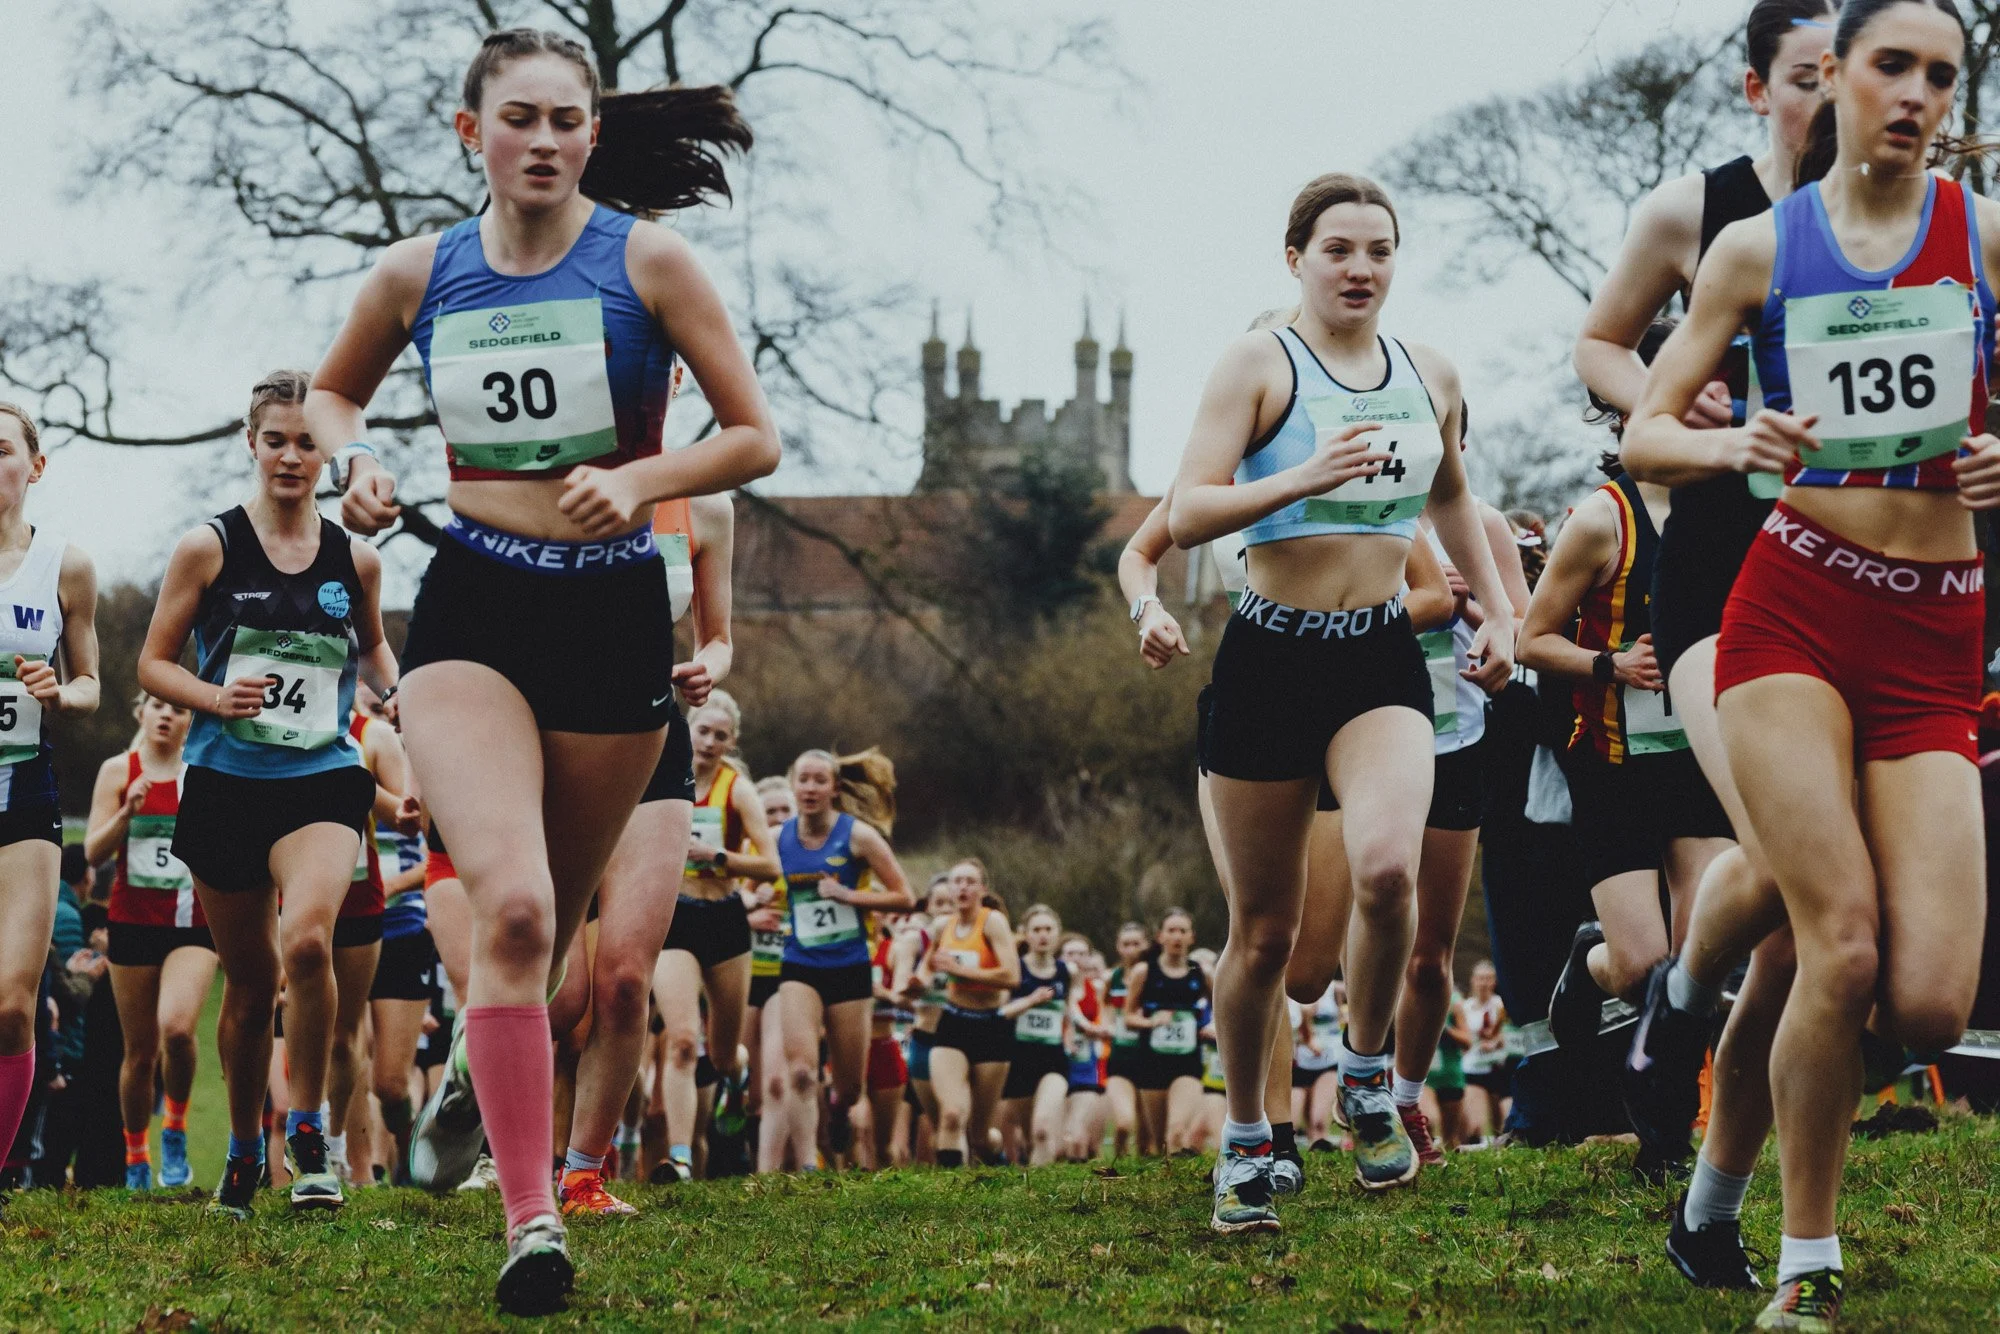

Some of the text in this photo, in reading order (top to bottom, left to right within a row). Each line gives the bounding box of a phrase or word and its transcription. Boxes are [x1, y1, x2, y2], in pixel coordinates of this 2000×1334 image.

[469, 331, 561, 349] SEDGEFIELD
[1827, 317, 1929, 336] SEDGEFIELD
[482, 368, 557, 423] 30
[1828, 353, 1936, 416] 136
[1342, 411, 1410, 423] SEDGEFIELD
[468, 529, 651, 569] NIKE PRO
[1823, 547, 1921, 593] PRO
[13, 604, 45, 632] W
[1295, 607, 1373, 640] PRO
[1383, 594, 1404, 625] NI
[259, 647, 321, 664] SEDGEFIELD
[262, 673, 307, 714] 34
[155, 847, 169, 868] 5
[814, 906, 837, 928] 21
